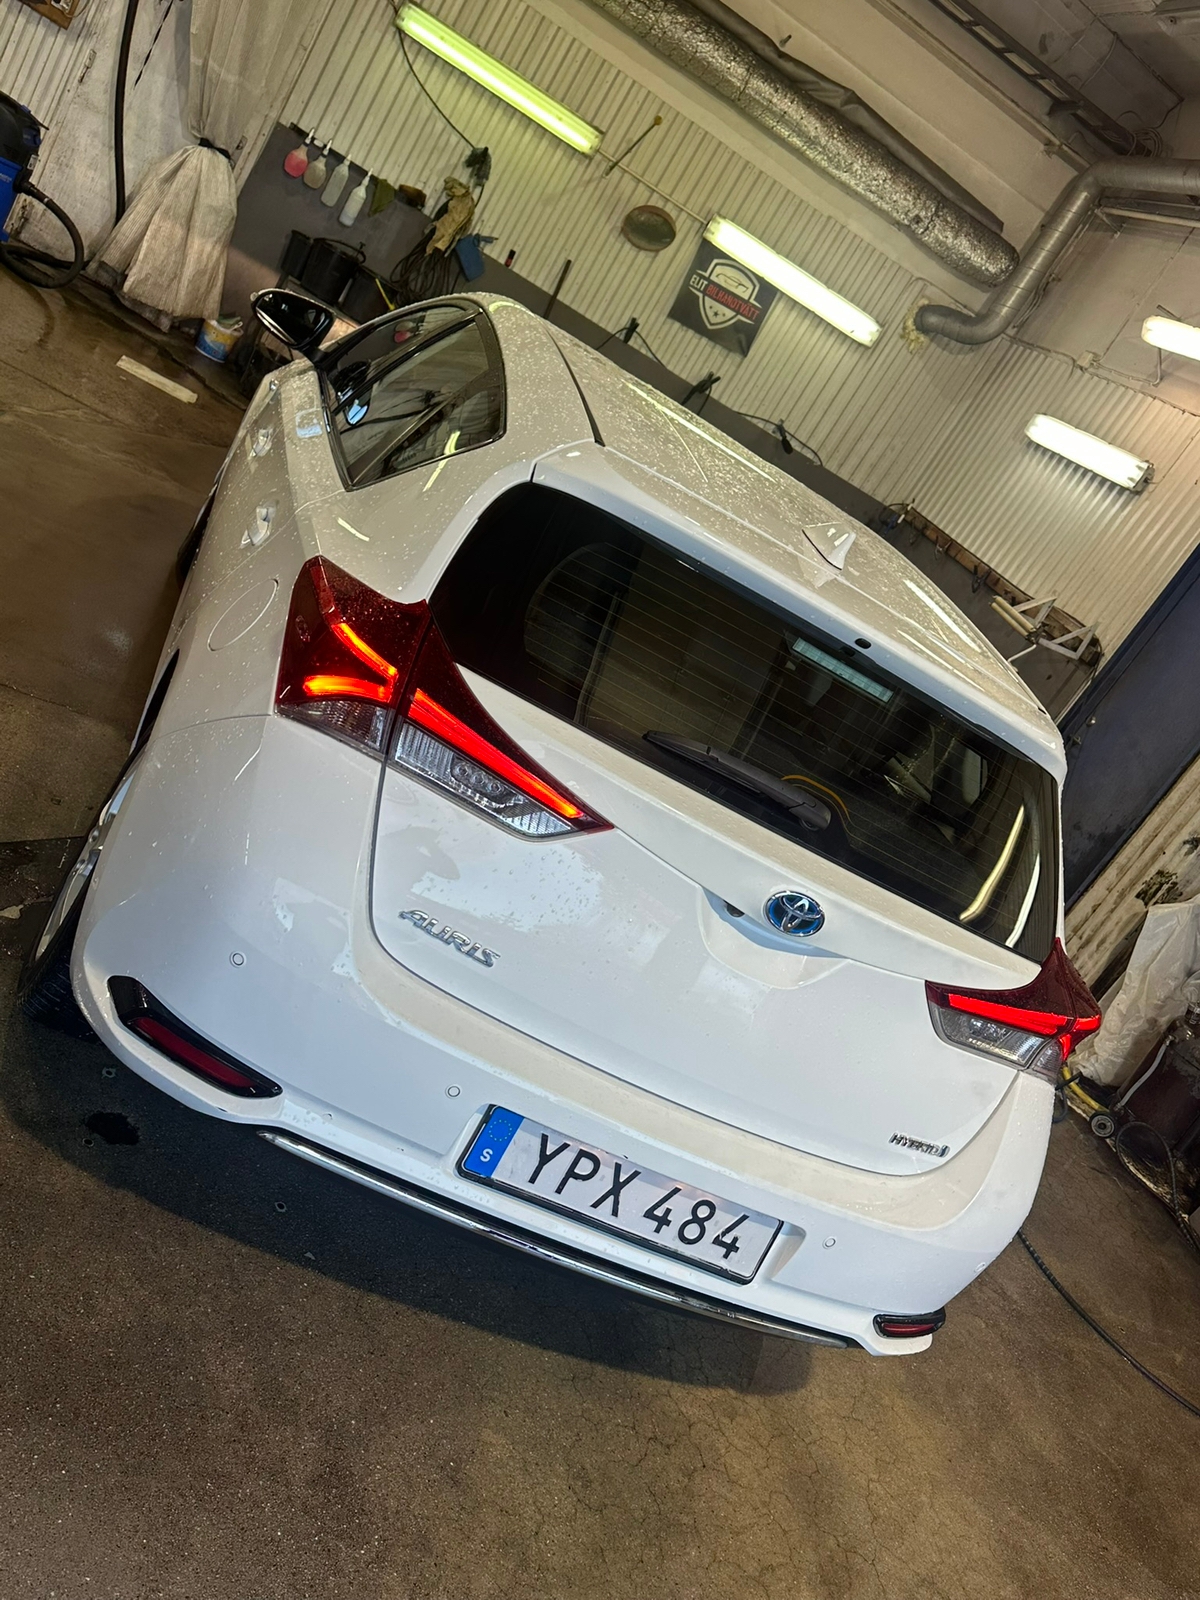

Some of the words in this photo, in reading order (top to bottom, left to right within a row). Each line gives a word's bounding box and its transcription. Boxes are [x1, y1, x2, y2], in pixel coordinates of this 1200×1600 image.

[689, 274, 708, 292] ELIT
[706, 284, 760, 320] BILHANDTVÄTT
[398, 910, 501, 968] AURIS
[479, 1147, 494, 1163] S
[888, 1132, 942, 1156] HYBRID
[528, 1132, 642, 1218] YPX
[643, 1186, 750, 1260] 484
